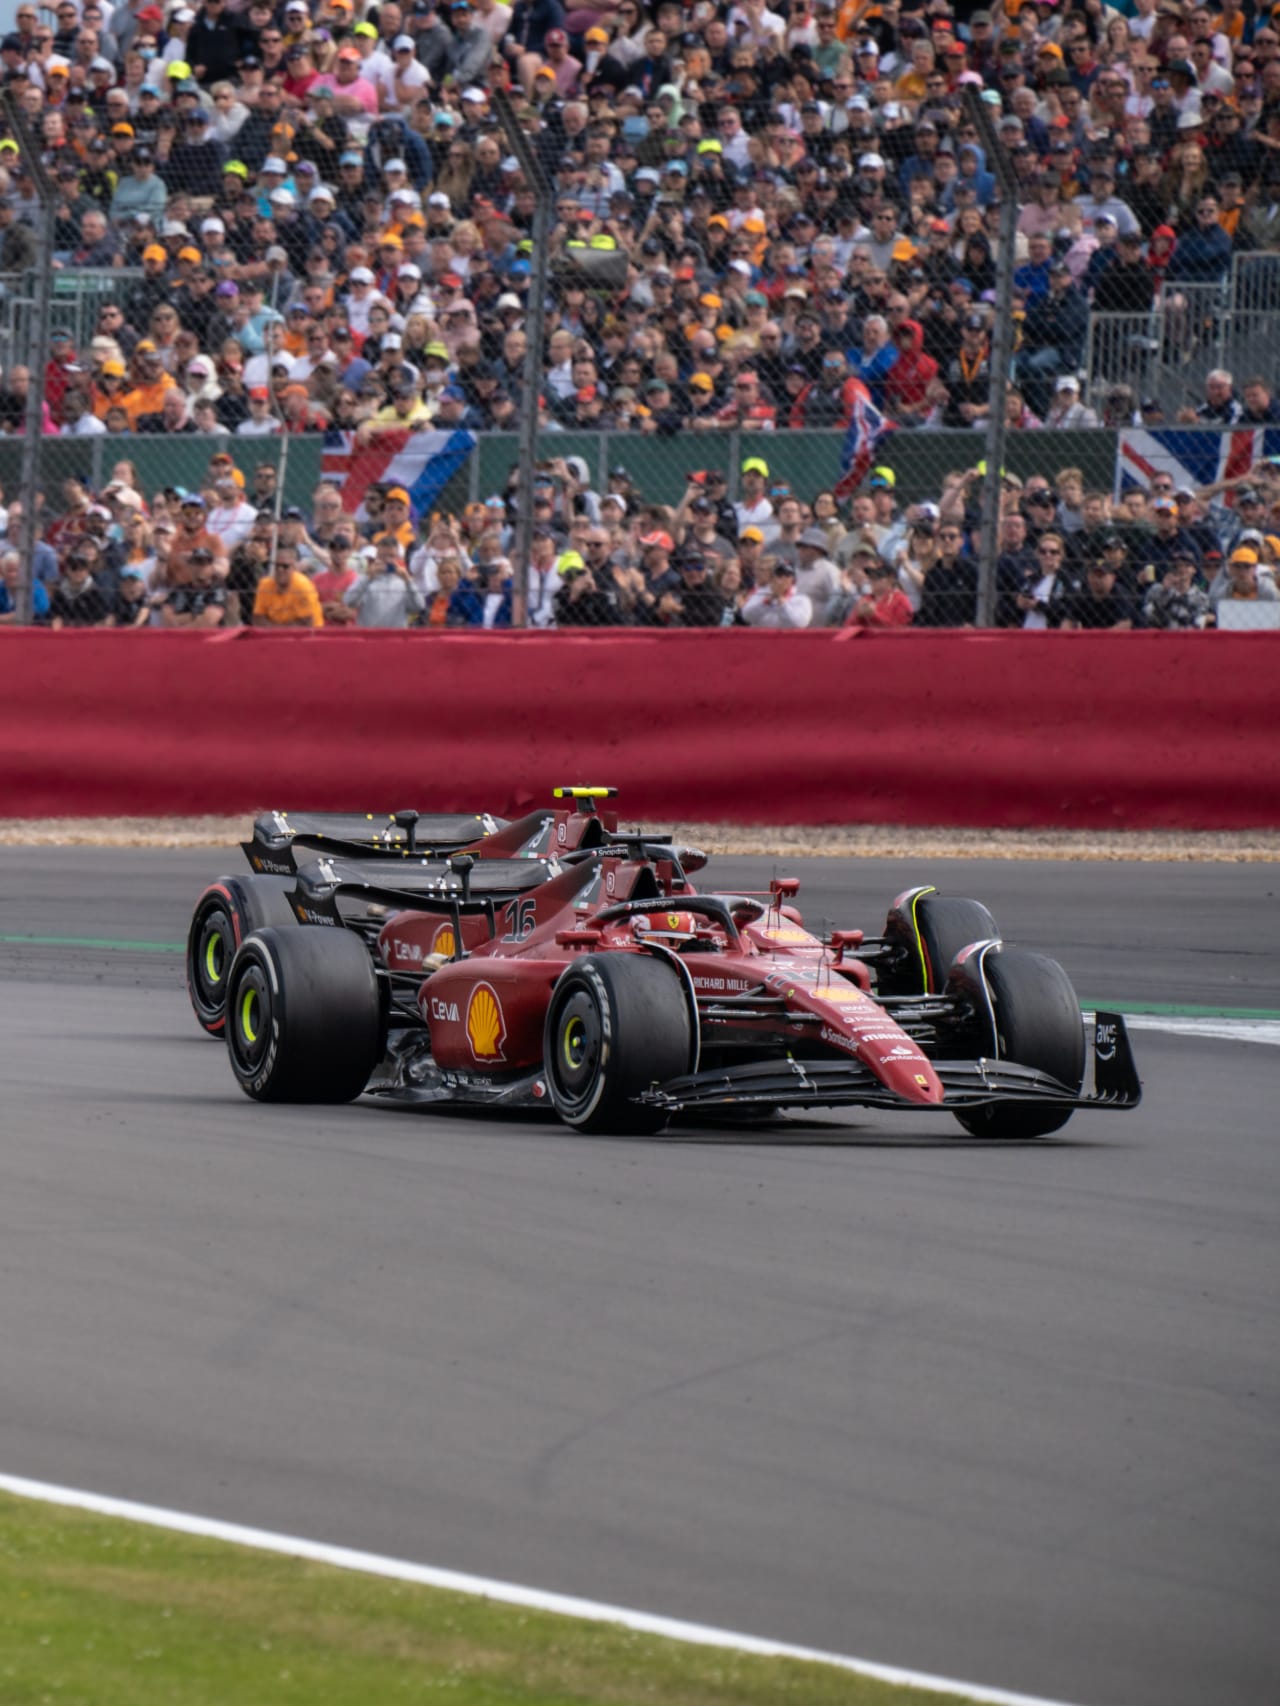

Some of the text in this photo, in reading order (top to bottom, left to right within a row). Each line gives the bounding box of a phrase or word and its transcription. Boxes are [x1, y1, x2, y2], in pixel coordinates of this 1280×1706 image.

[501, 899, 537, 944] 16
[693, 976, 750, 991] RICHARD MILLE
